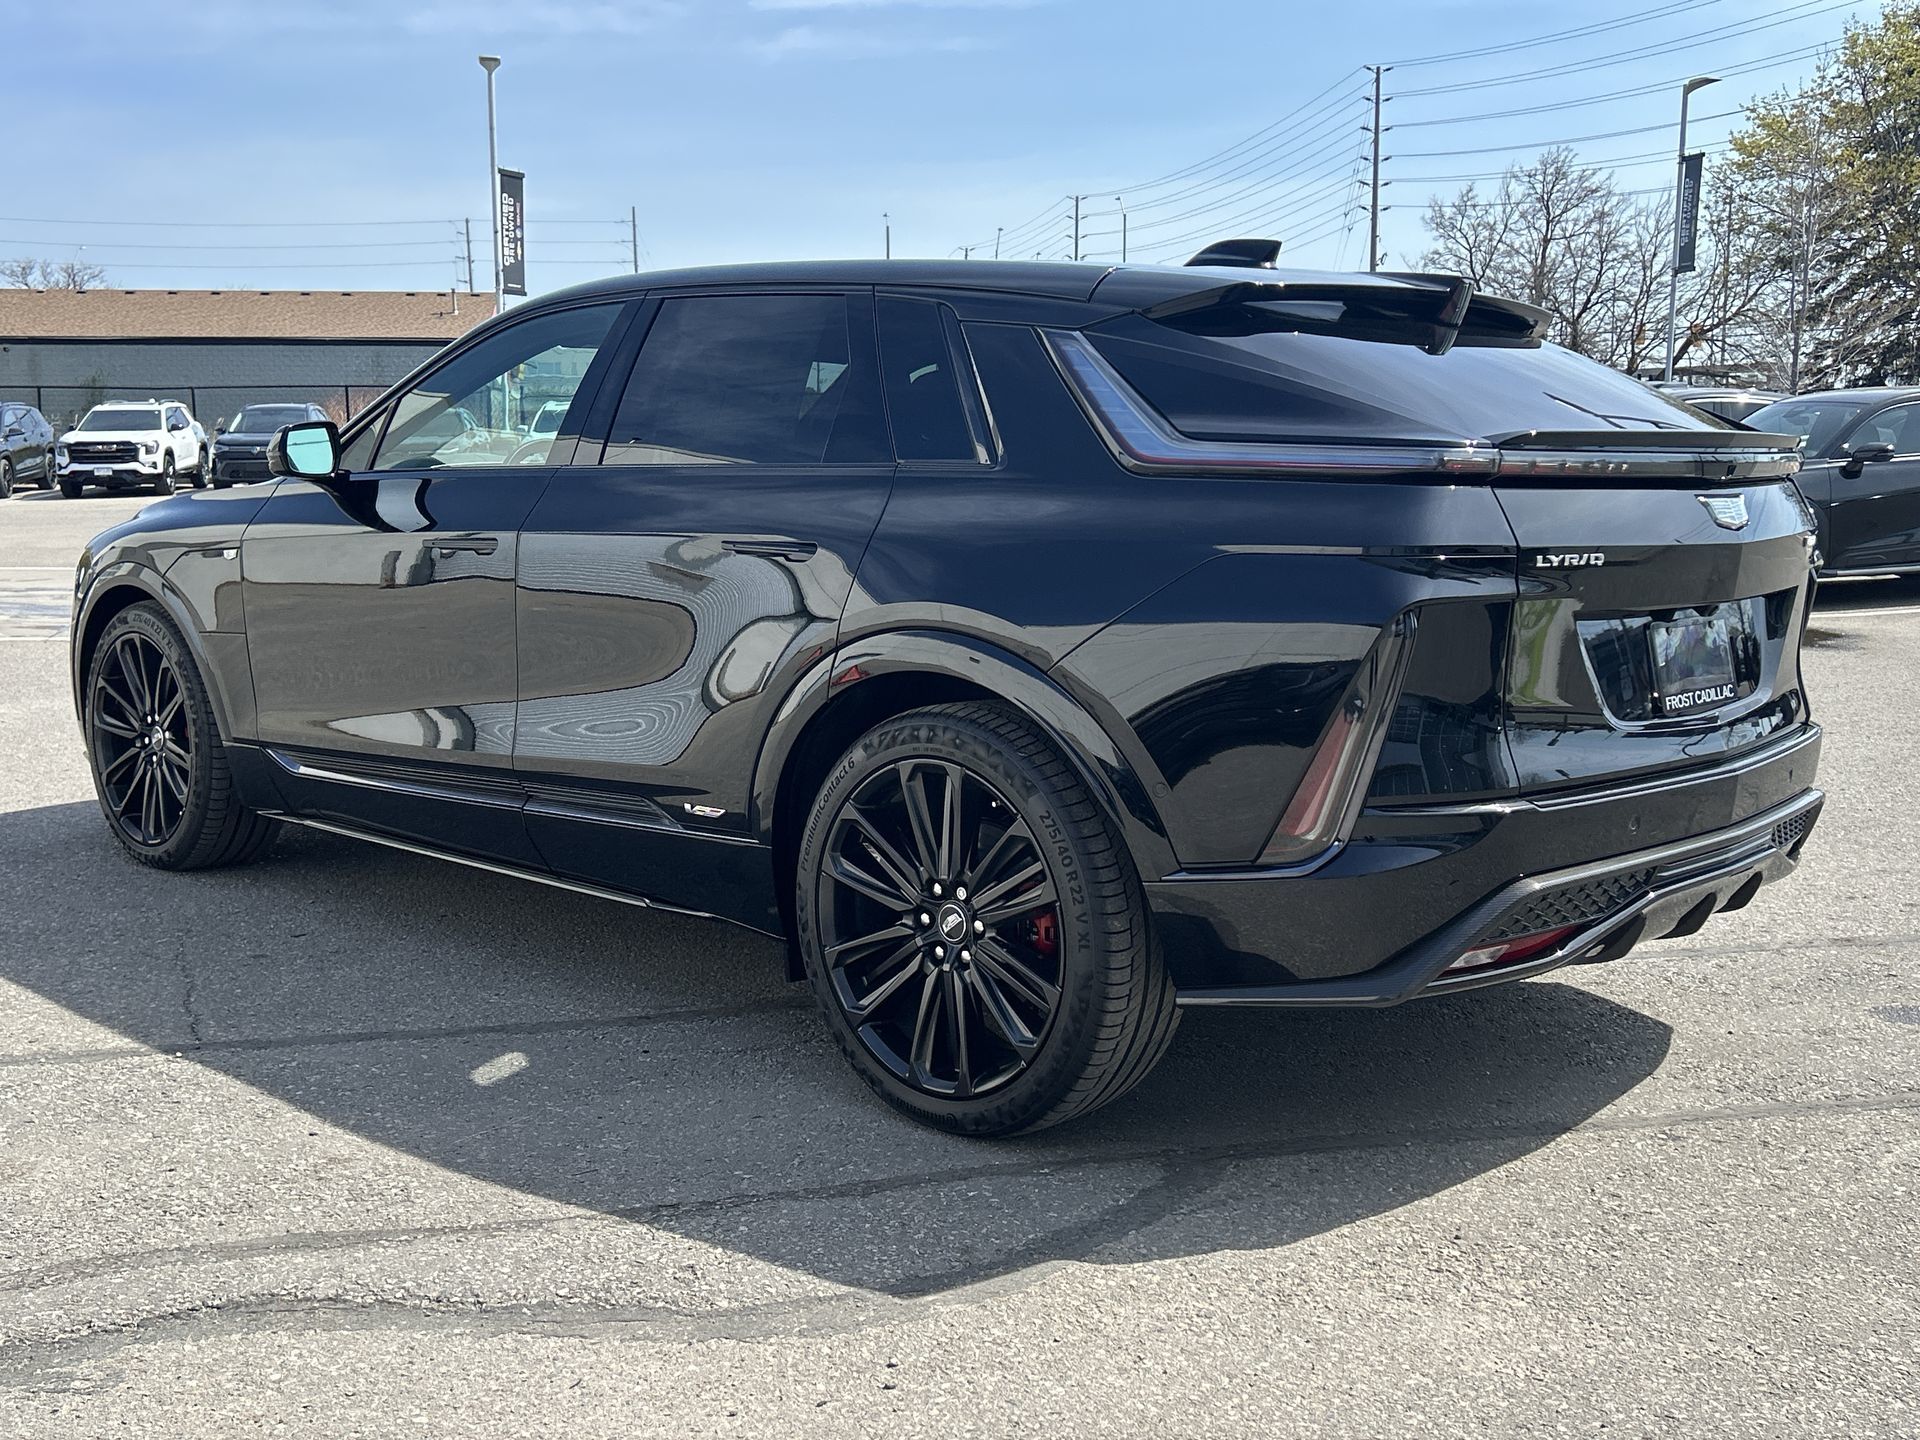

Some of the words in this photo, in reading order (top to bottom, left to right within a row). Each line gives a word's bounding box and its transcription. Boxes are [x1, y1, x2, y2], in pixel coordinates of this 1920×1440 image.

[502, 192, 510, 266] CERTIFIED
[1665, 692, 1695, 710] FROST
[1695, 684, 1735, 704] CADILLAC
[800, 766, 849, 872] PremiumContact
[848, 756, 855, 769] 6
[1039, 810, 1074, 868] 275/40
[1066, 872, 1078, 883] R
[1069, 884, 1085, 906] 22
[1075, 911, 1089, 924] V
[1078, 931, 1090, 952] XL
